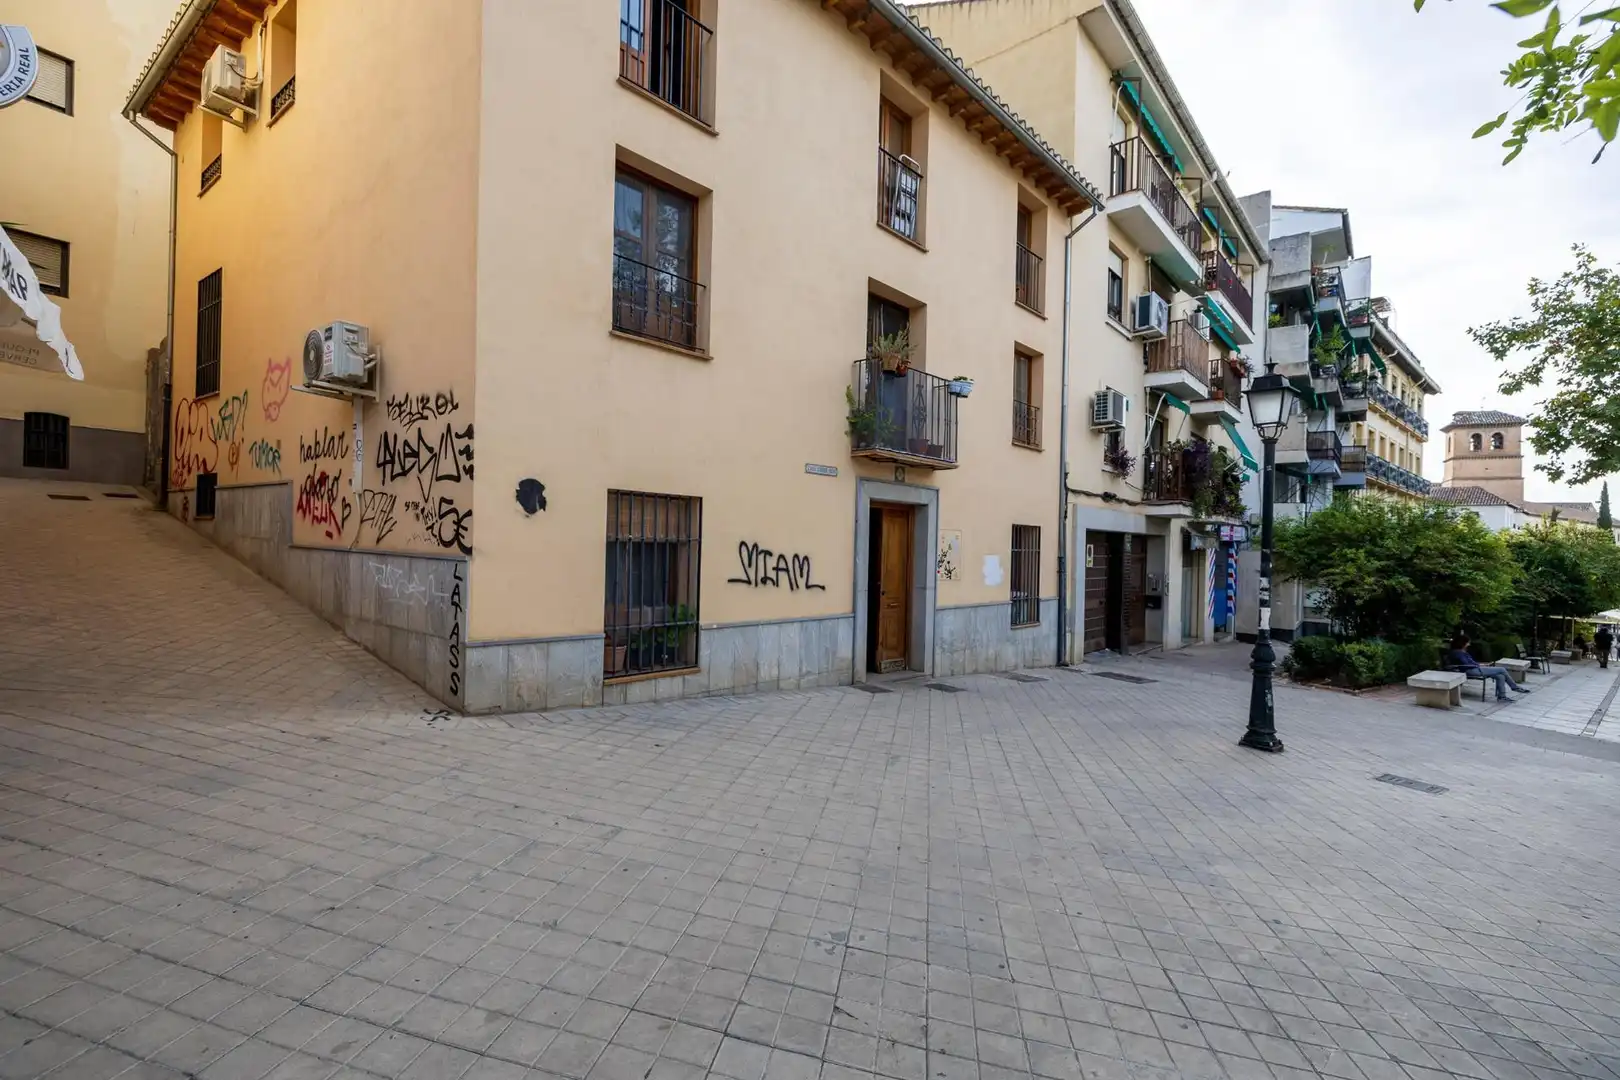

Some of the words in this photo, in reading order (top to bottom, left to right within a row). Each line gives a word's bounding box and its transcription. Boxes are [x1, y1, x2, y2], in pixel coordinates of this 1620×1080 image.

[17, 47, 31, 76] REAL
[299, 426, 349, 463] hablar
[727, 540, 826, 592] MIAM
